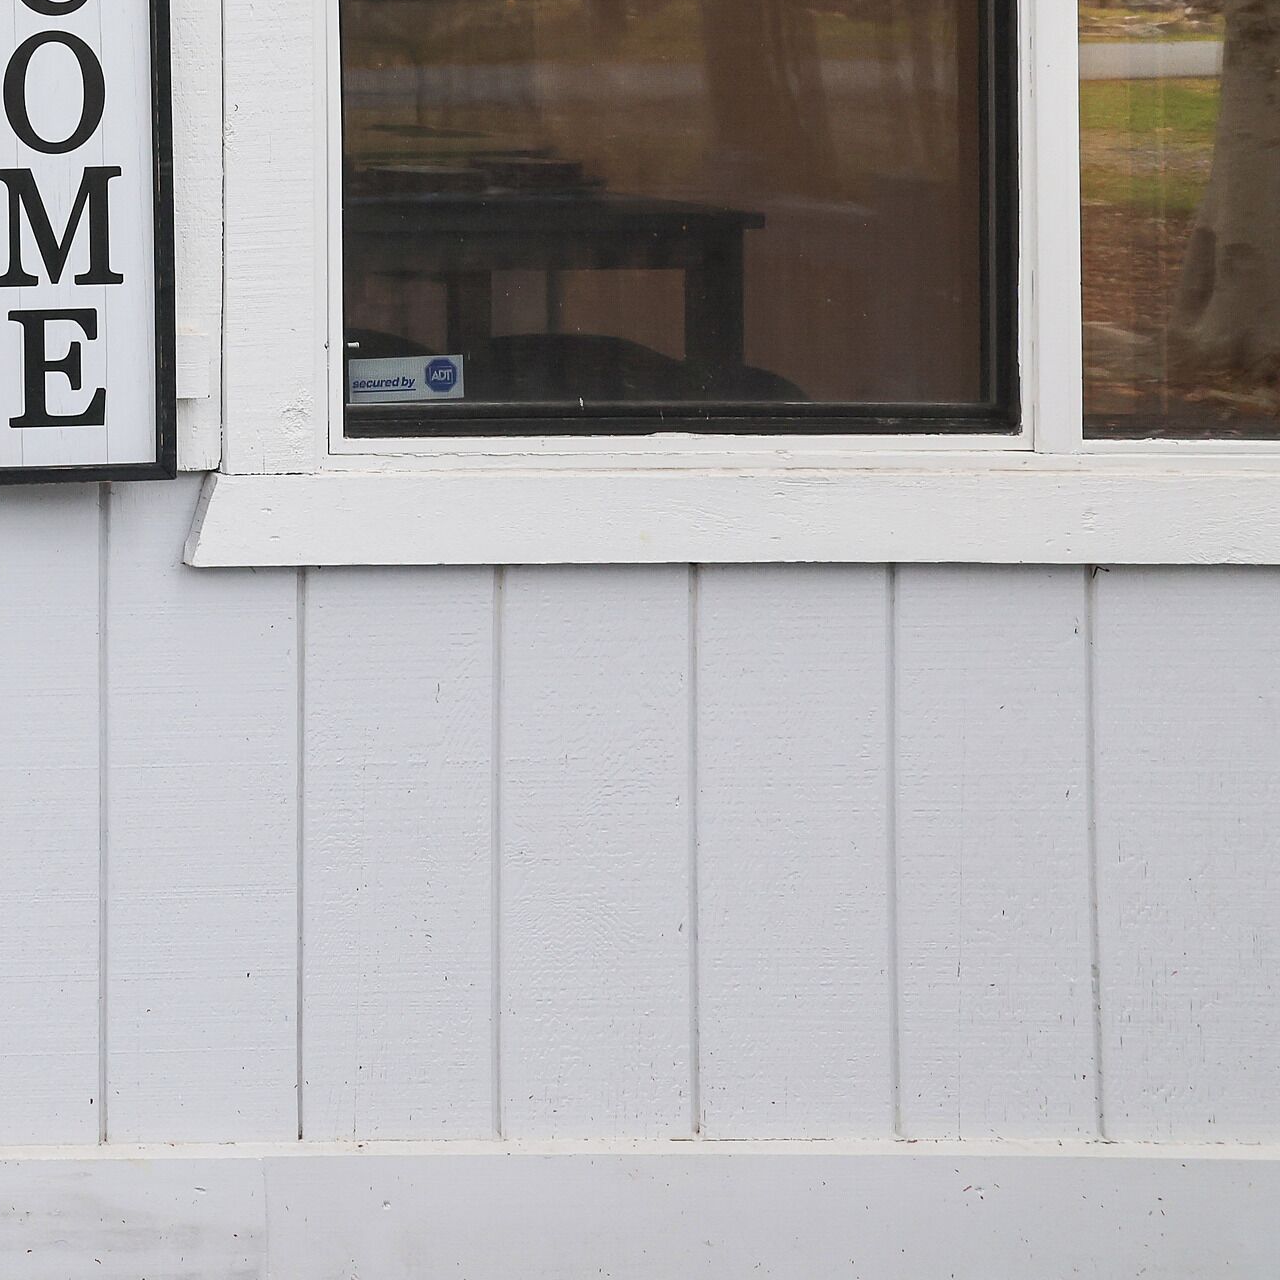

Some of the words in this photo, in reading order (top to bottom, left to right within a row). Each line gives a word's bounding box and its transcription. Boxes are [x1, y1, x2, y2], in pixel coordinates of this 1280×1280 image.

[431, 369, 453, 382] ADT
[352, 376, 400, 389] secured
[401, 376, 416, 389] by
